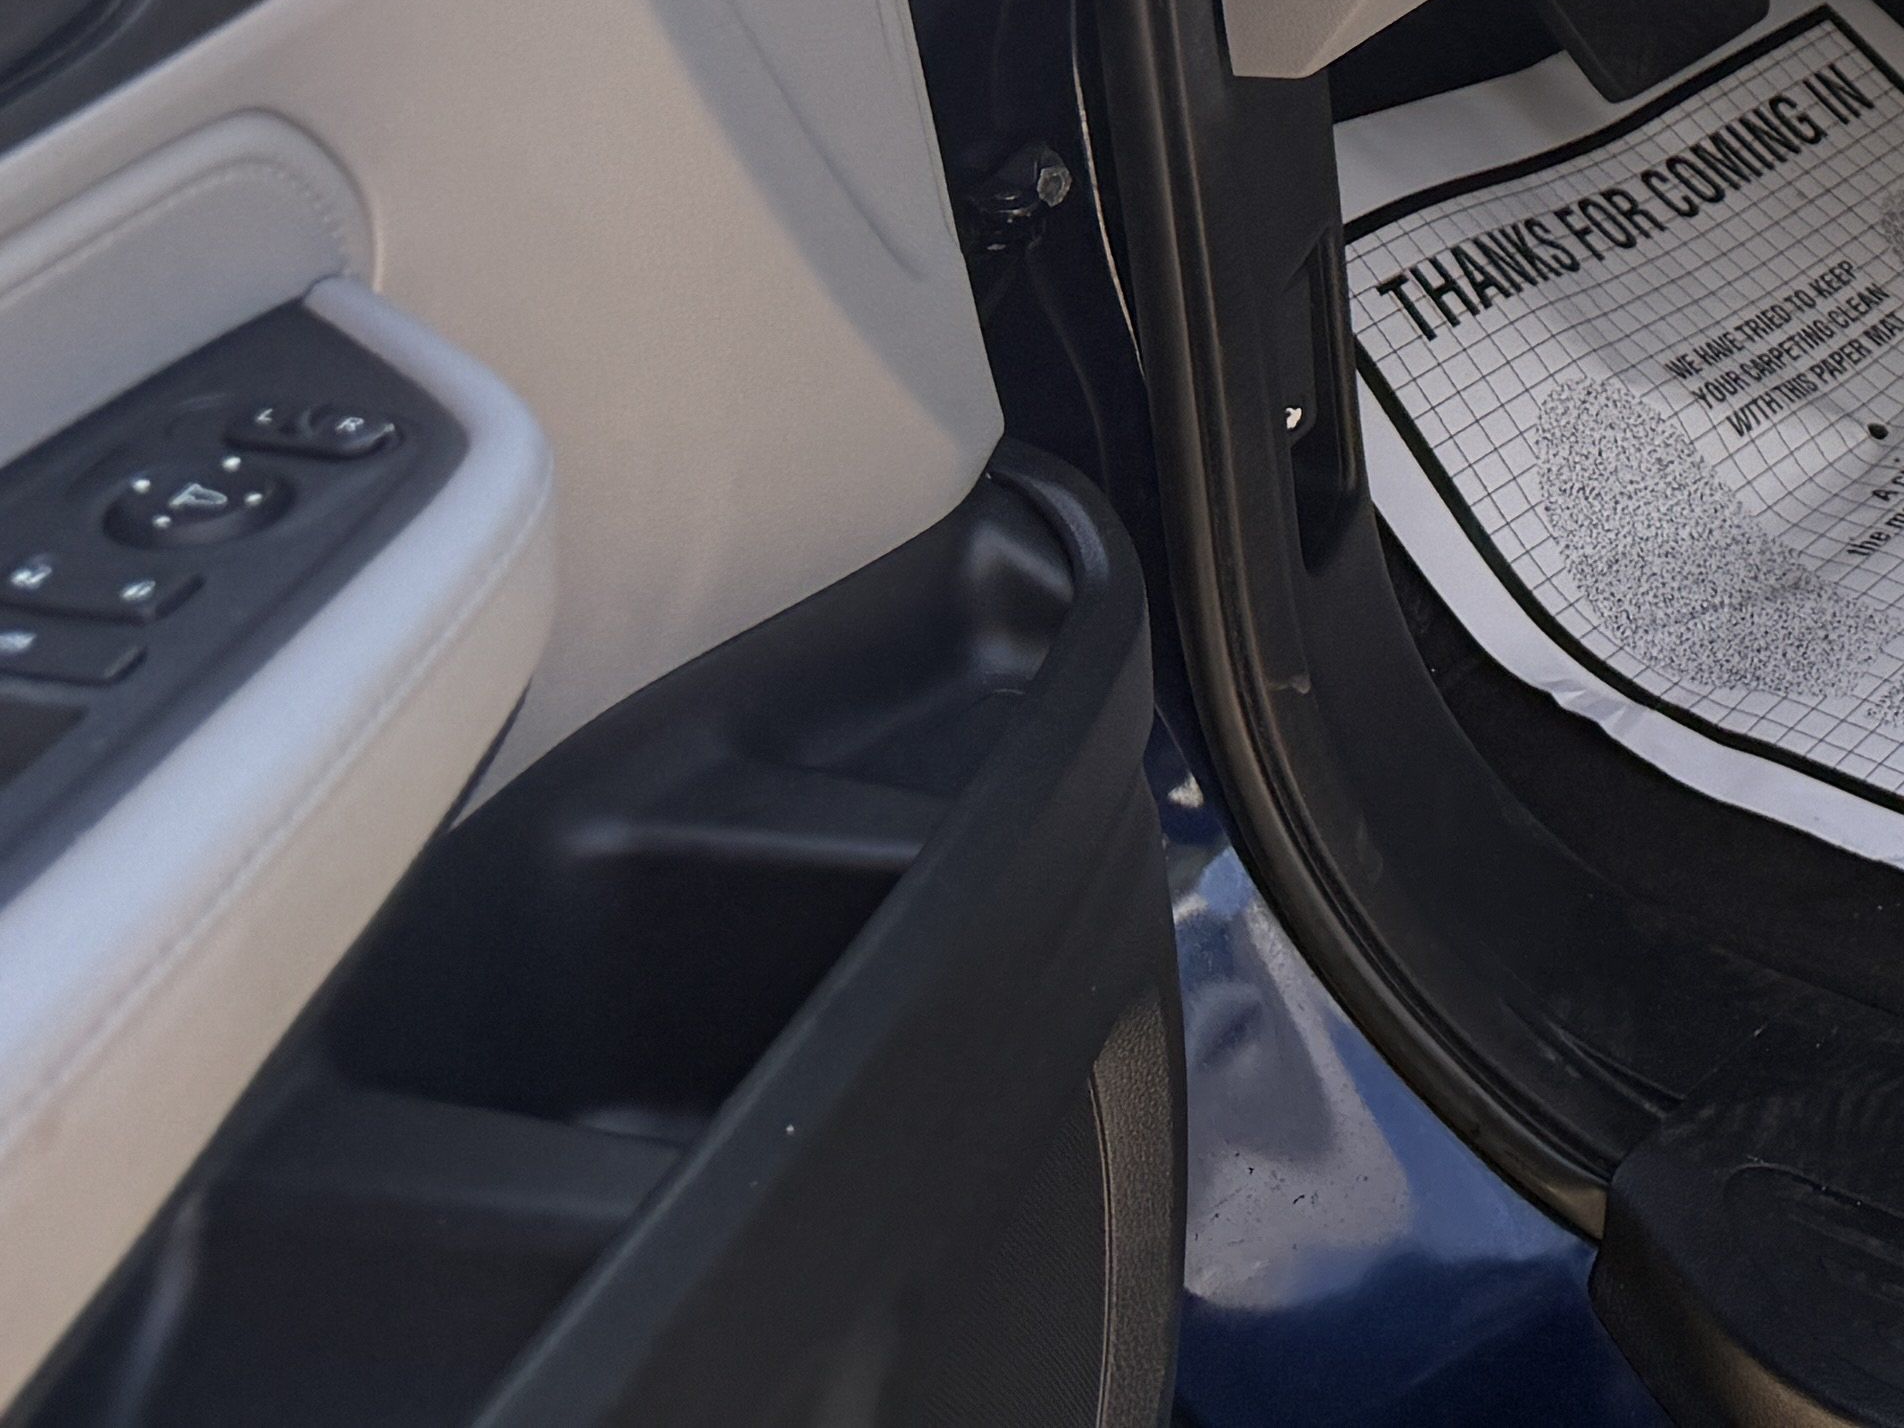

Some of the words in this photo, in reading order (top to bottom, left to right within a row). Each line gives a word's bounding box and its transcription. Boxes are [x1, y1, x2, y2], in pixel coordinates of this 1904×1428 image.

[1377, 217, 1580, 341] THANKS
[1554, 186, 1664, 262] FOR
[1640, 94, 1827, 217] COMING
[1802, 63, 1874, 125] IN
[1664, 353, 1703, 381] WE
[1693, 331, 1743, 366] HAVE
[1734, 304, 1792, 343] TRIED
[1784, 290, 1816, 313] TO
[1809, 260, 1857, 300] KEEP
[1692, 370, 1751, 409] YOUR
[1740, 319, 1835, 382] CARPETING
[1827, 283, 1890, 329] CLEAN
[1726, 389, 1783, 437] WITH
[1773, 374, 1819, 403] THIS
[1810, 338, 1873, 384] PAPER
[1848, 530, 1891, 556] the
[1872, 489, 1896, 502] A
